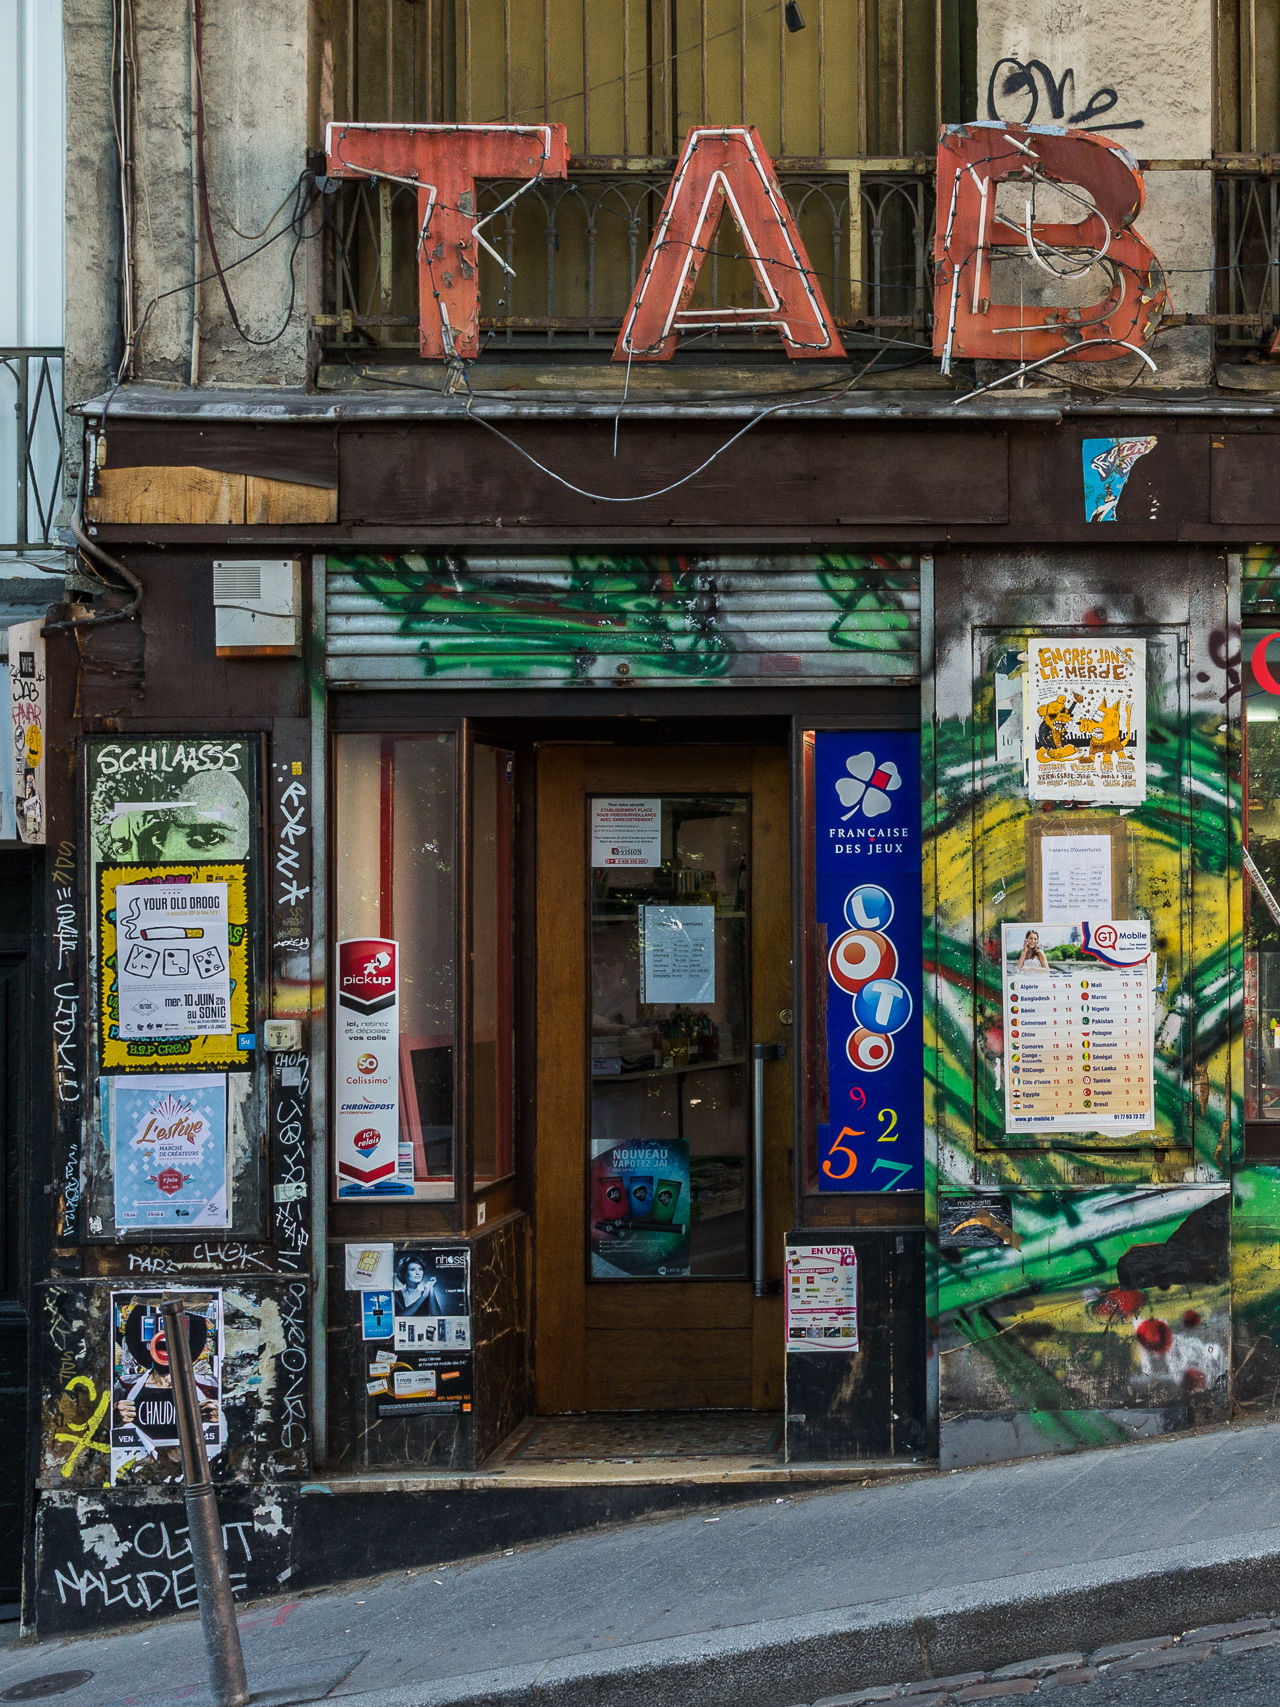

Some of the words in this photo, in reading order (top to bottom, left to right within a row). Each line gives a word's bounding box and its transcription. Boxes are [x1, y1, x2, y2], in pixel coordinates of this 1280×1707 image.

[1039, 666, 1060, 680] LA
[829, 828, 909, 838] FRANÇAISE
[835, 844, 861, 854] DES
[867, 844, 903, 854] JEUX
[144, 897, 168, 910] YOUR
[171, 896, 187, 909] OLD
[190, 896, 220, 909] DROOG
[1265, 893, 1280, 918] TOWER
[1098, 932, 1113, 942] GT
[1119, 932, 1147, 940] Mobile
[343, 974, 392, 986] pickup
[832, 890, 908, 1068] LOTO
[164, 998, 183, 1007] mer.
[184, 994, 193, 1006] 10
[195, 994, 215, 1006] JUIN
[187, 1007, 197, 1019] au
[199, 1006, 226, 1019] SONIC
[346, 1020, 359, 1028] ici,
[361, 1020, 388, 1028] retirez
[345, 1027, 353, 1035] et
[356, 1027, 390, 1035] déposez
[240, 1037, 250, 1045] Su
[360, 1058, 374, 1068] SO
[347, 1076, 388, 1084] Colissimo
[849, 1086, 867, 1111] 9
[136, 1116, 203, 1144] L'estive
[877, 1108, 899, 1142] 2
[357, 1137, 379, 1148] relais
[613, 1149, 668, 1160] NOUVEAU
[822, 1126, 866, 1179] 5
[613, 1160, 650, 1168] VAPOTEZ
[138, 1401, 177, 1425] CHAUD
[119, 1435, 134, 1443] VEN
